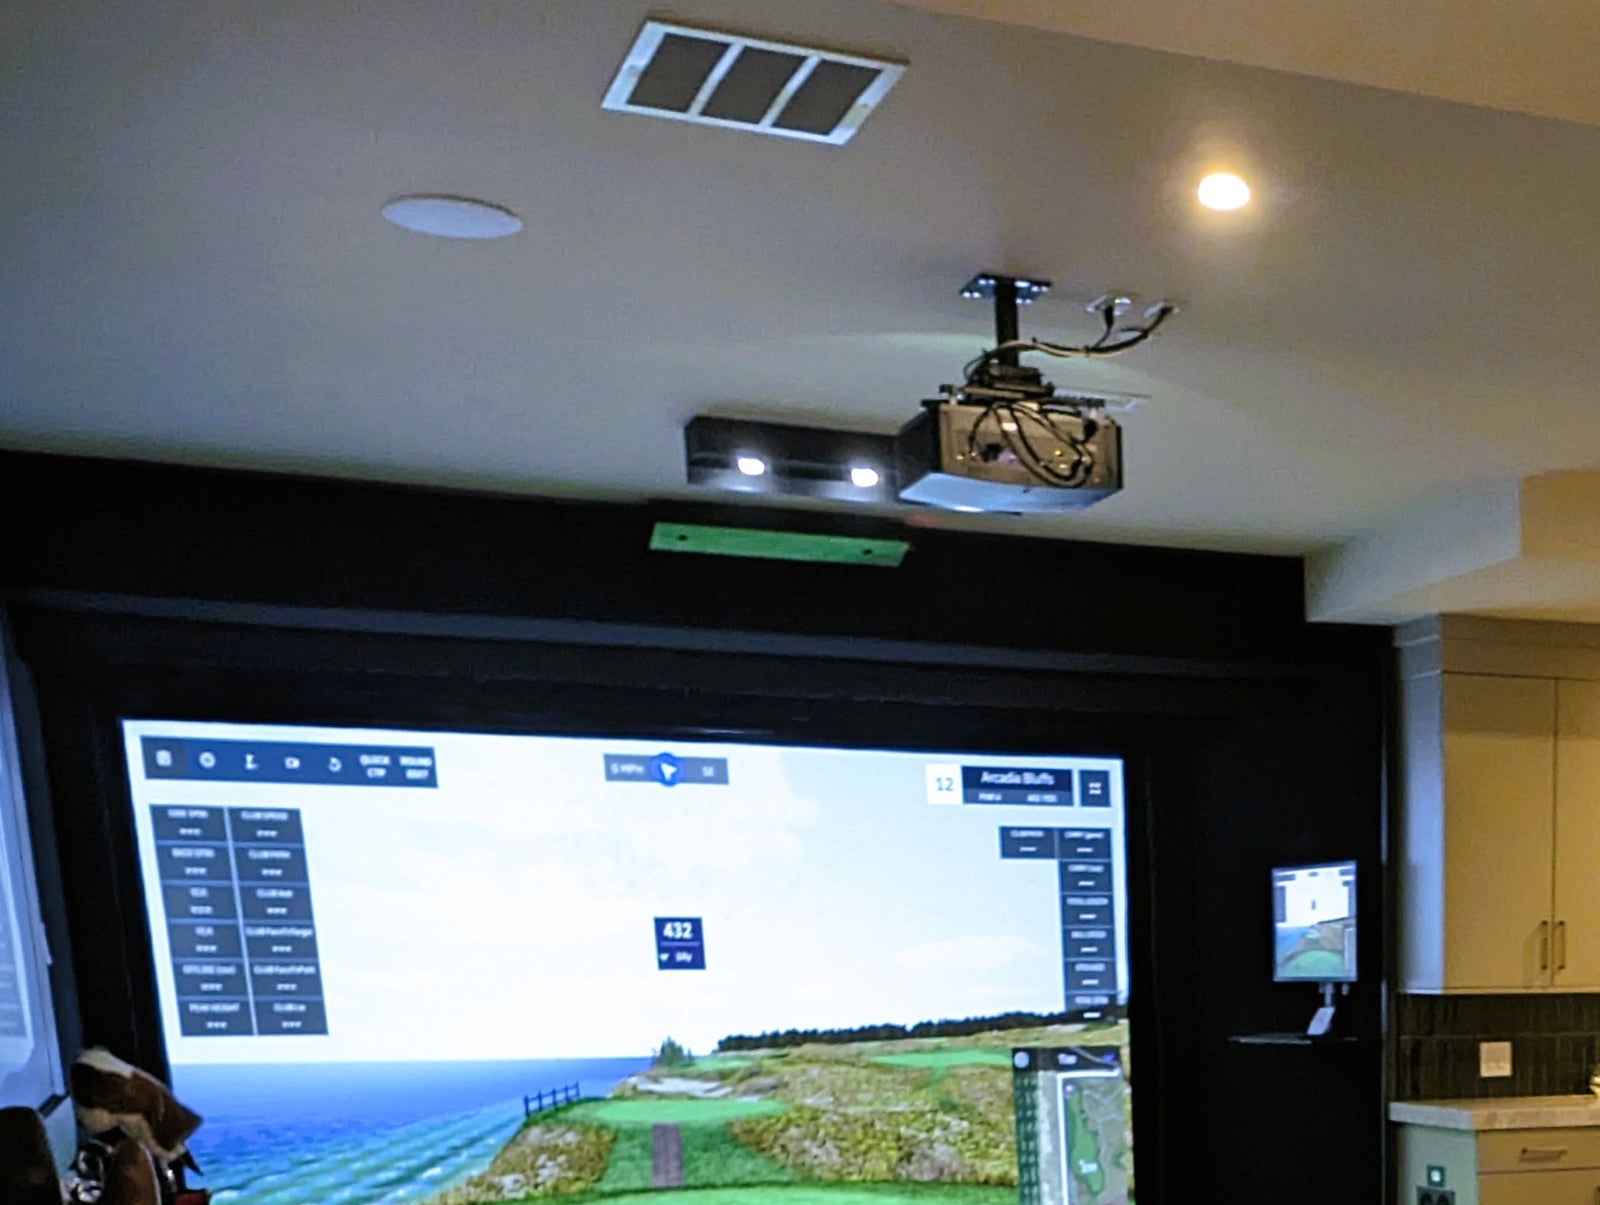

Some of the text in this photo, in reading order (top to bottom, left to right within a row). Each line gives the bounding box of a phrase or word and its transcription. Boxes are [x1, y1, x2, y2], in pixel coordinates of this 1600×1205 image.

[935, 777, 954, 791] 12
[980, 771, 1055, 785] Arcadia Bluffs
[663, 922, 693, 939] 432
